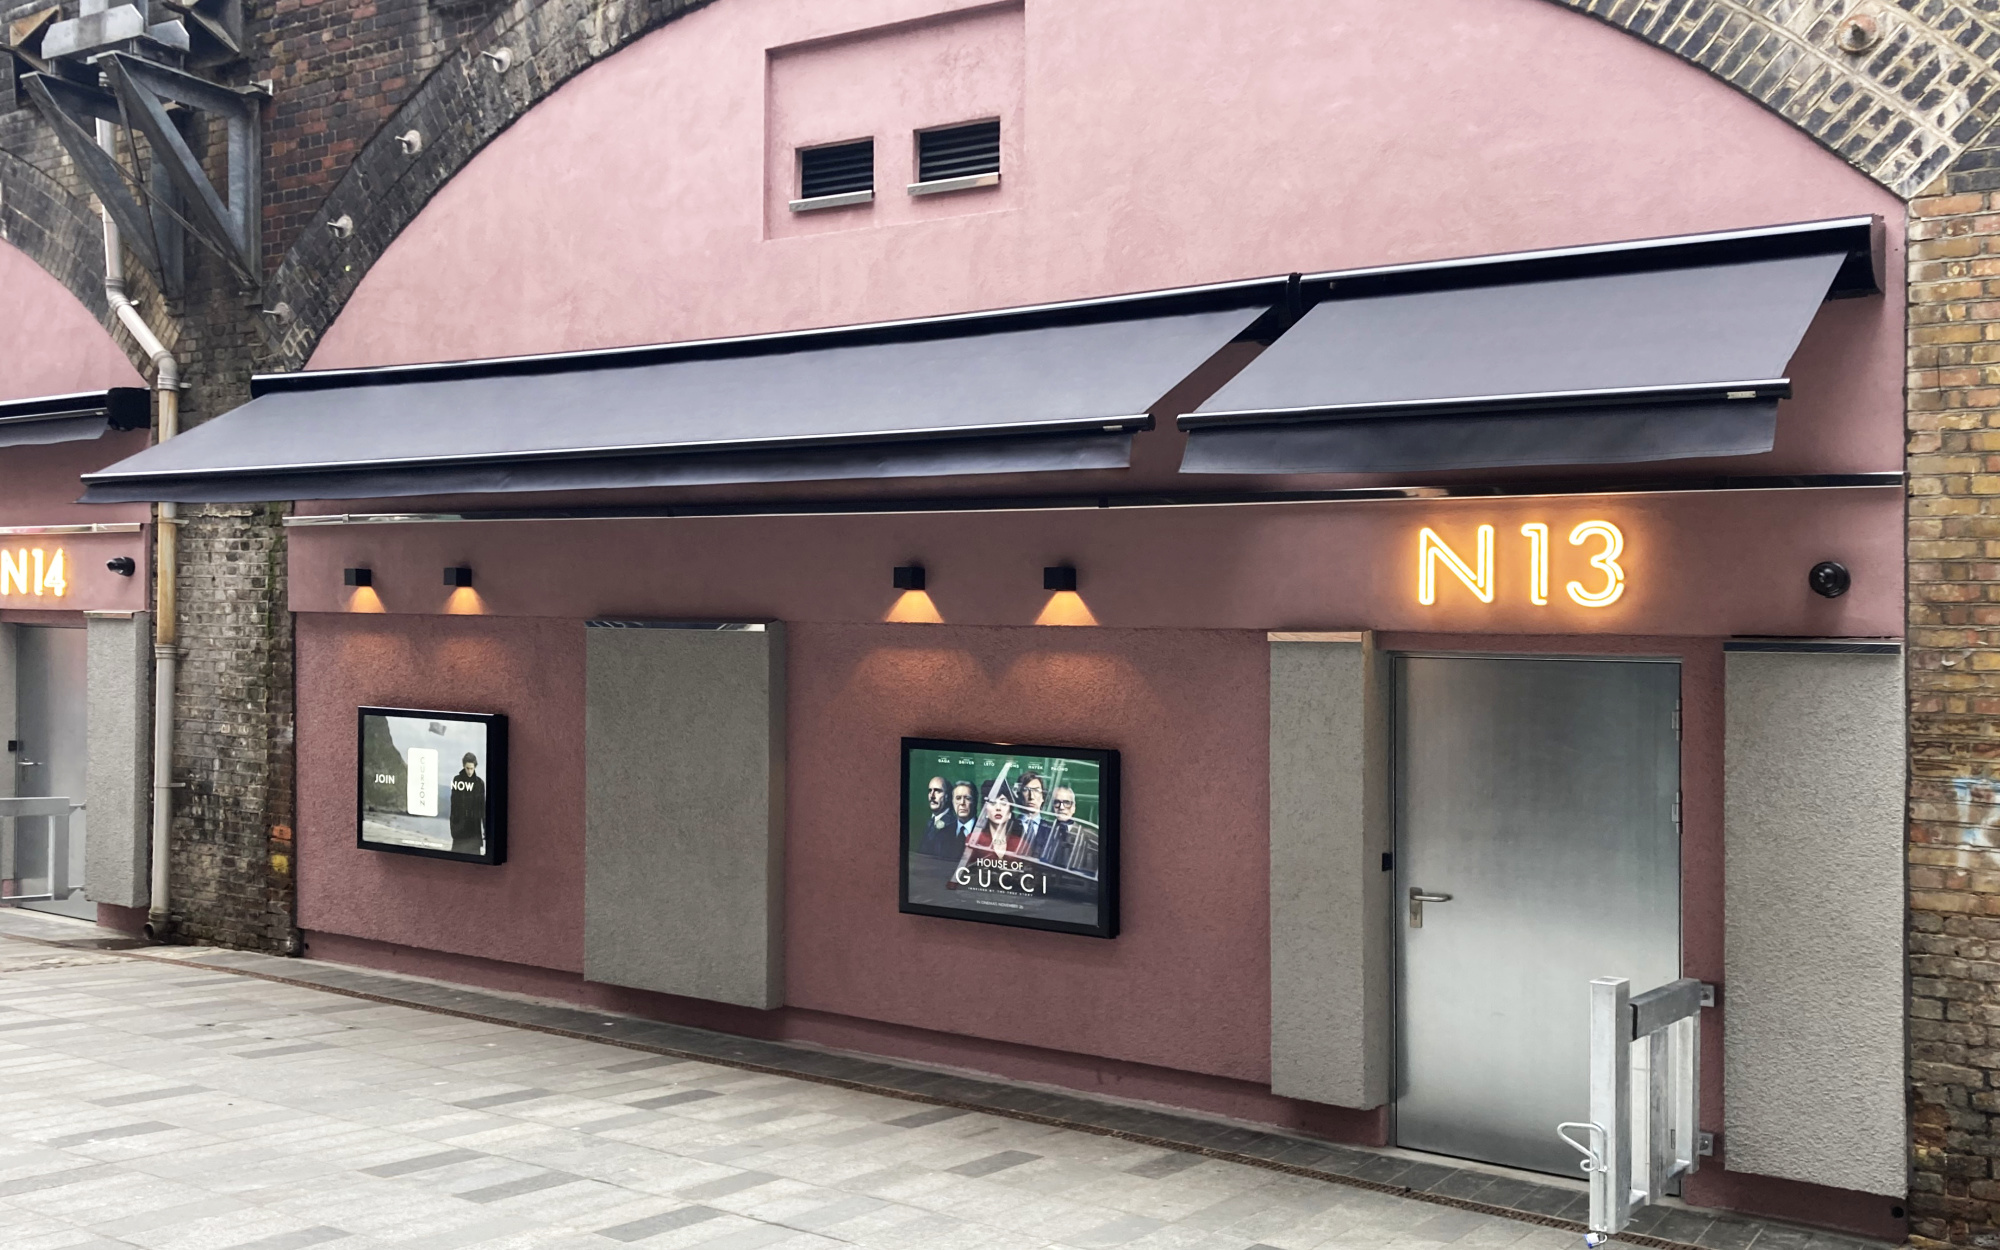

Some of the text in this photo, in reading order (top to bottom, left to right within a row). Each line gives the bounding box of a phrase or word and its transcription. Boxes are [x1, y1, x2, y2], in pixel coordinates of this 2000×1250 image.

[0, 547, 67, 597] N14
[1418, 519, 1626, 608] N13
[374, 756, 475, 808] JOIN CURZON NOW
[955, 866, 1047, 895] GUCCI
[976, 857, 1024, 871] HOUSE OF
